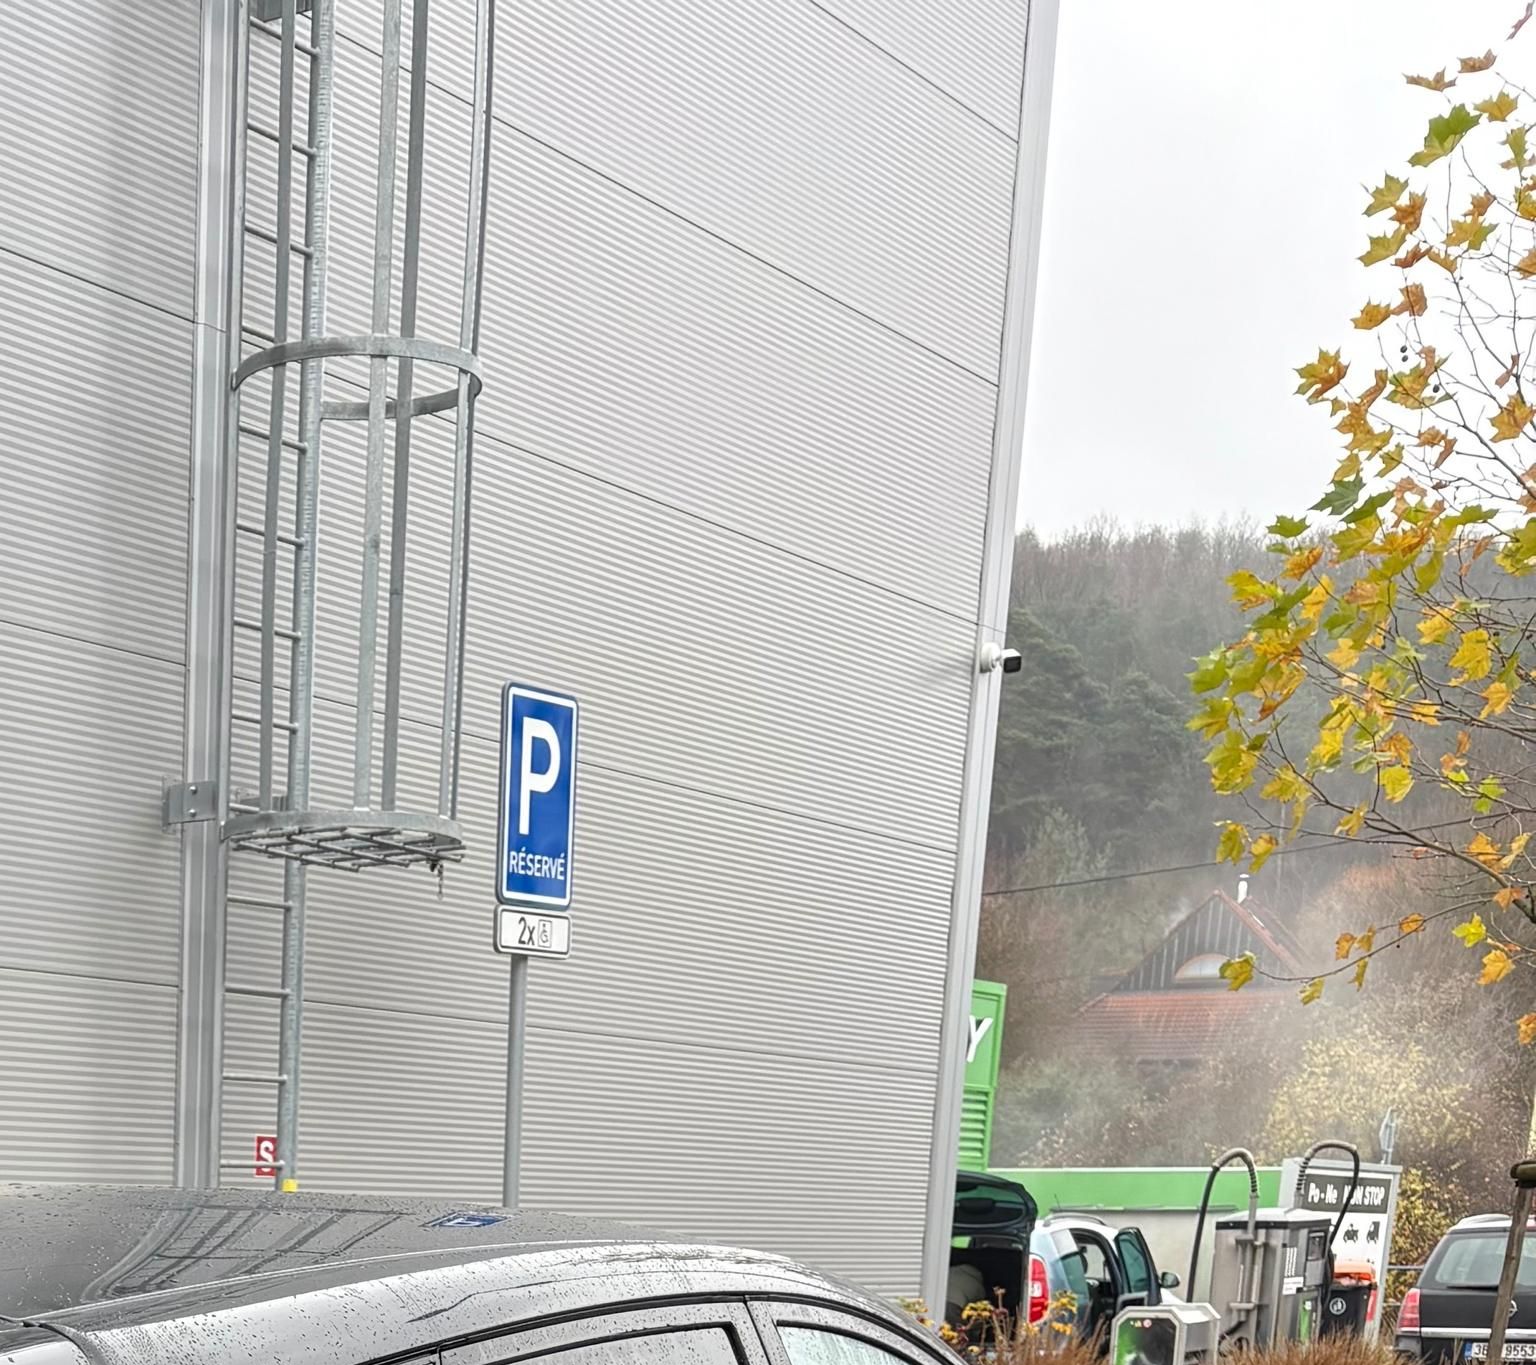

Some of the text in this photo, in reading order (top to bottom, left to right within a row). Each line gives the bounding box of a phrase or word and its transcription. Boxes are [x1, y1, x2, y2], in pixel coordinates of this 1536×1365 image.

[519, 716, 561, 836] P
[509, 846, 566, 881] RÉSERVÉ
[518, 916, 535, 946] 2x
[1308, 1182, 1320, 1204] Po
[1325, 1183, 1338, 1204] Ne
[1364, 1185, 1385, 1206] STOP
